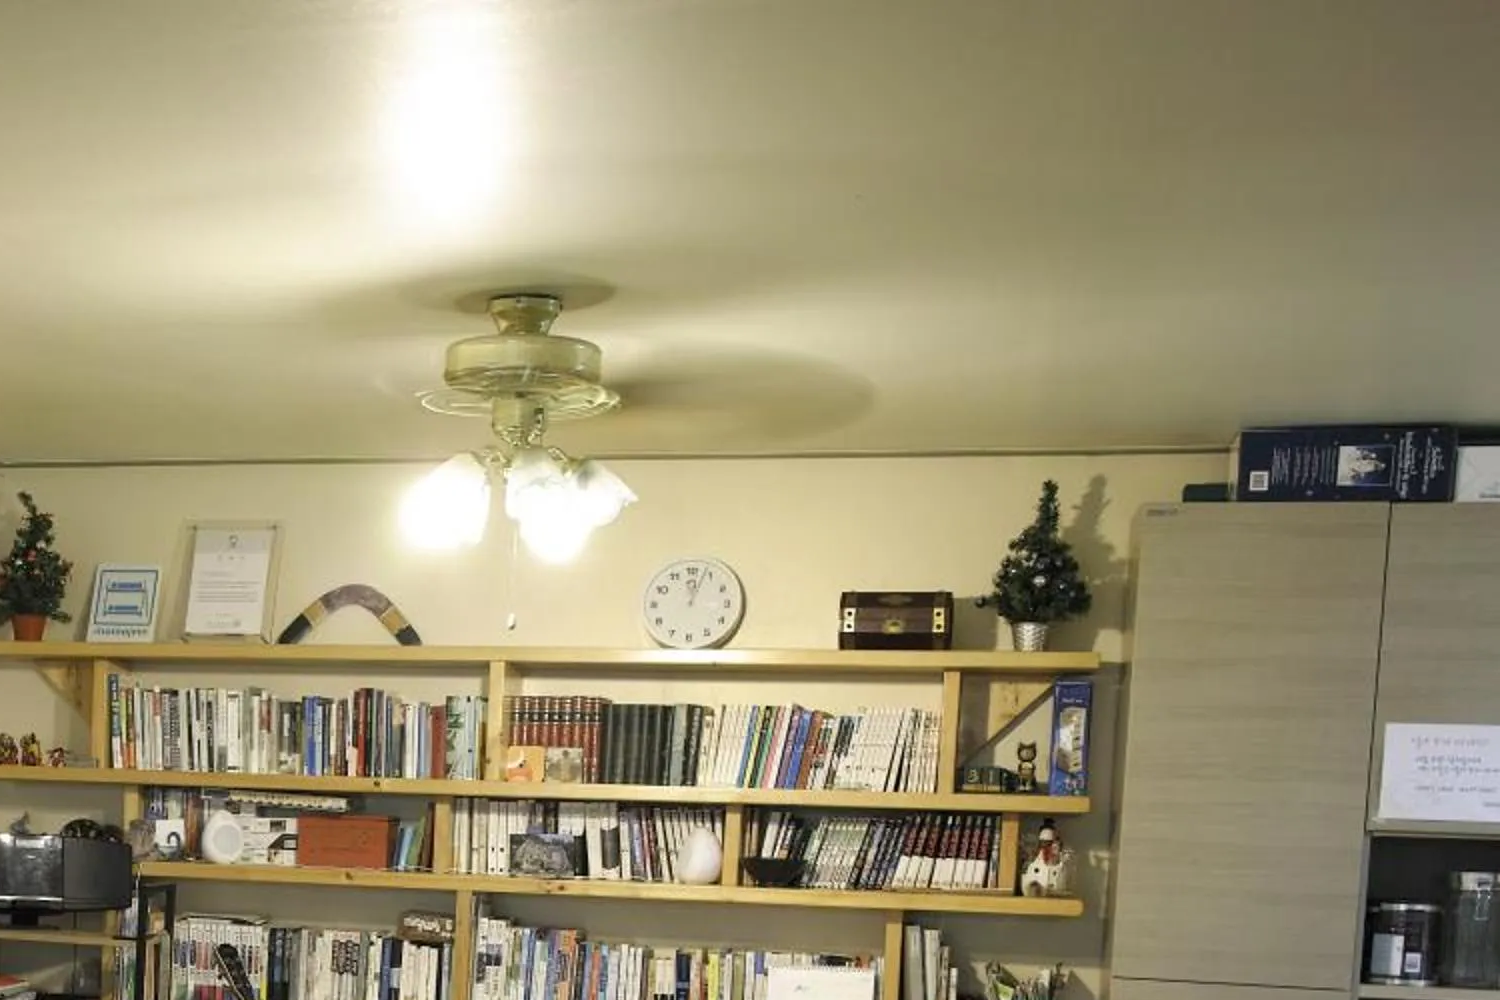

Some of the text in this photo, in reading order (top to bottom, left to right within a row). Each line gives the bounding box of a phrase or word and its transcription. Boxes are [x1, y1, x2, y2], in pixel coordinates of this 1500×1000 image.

[656, 585, 668, 595] 10
[668, 629, 676, 638] 7
[703, 628, 711, 637] 5
